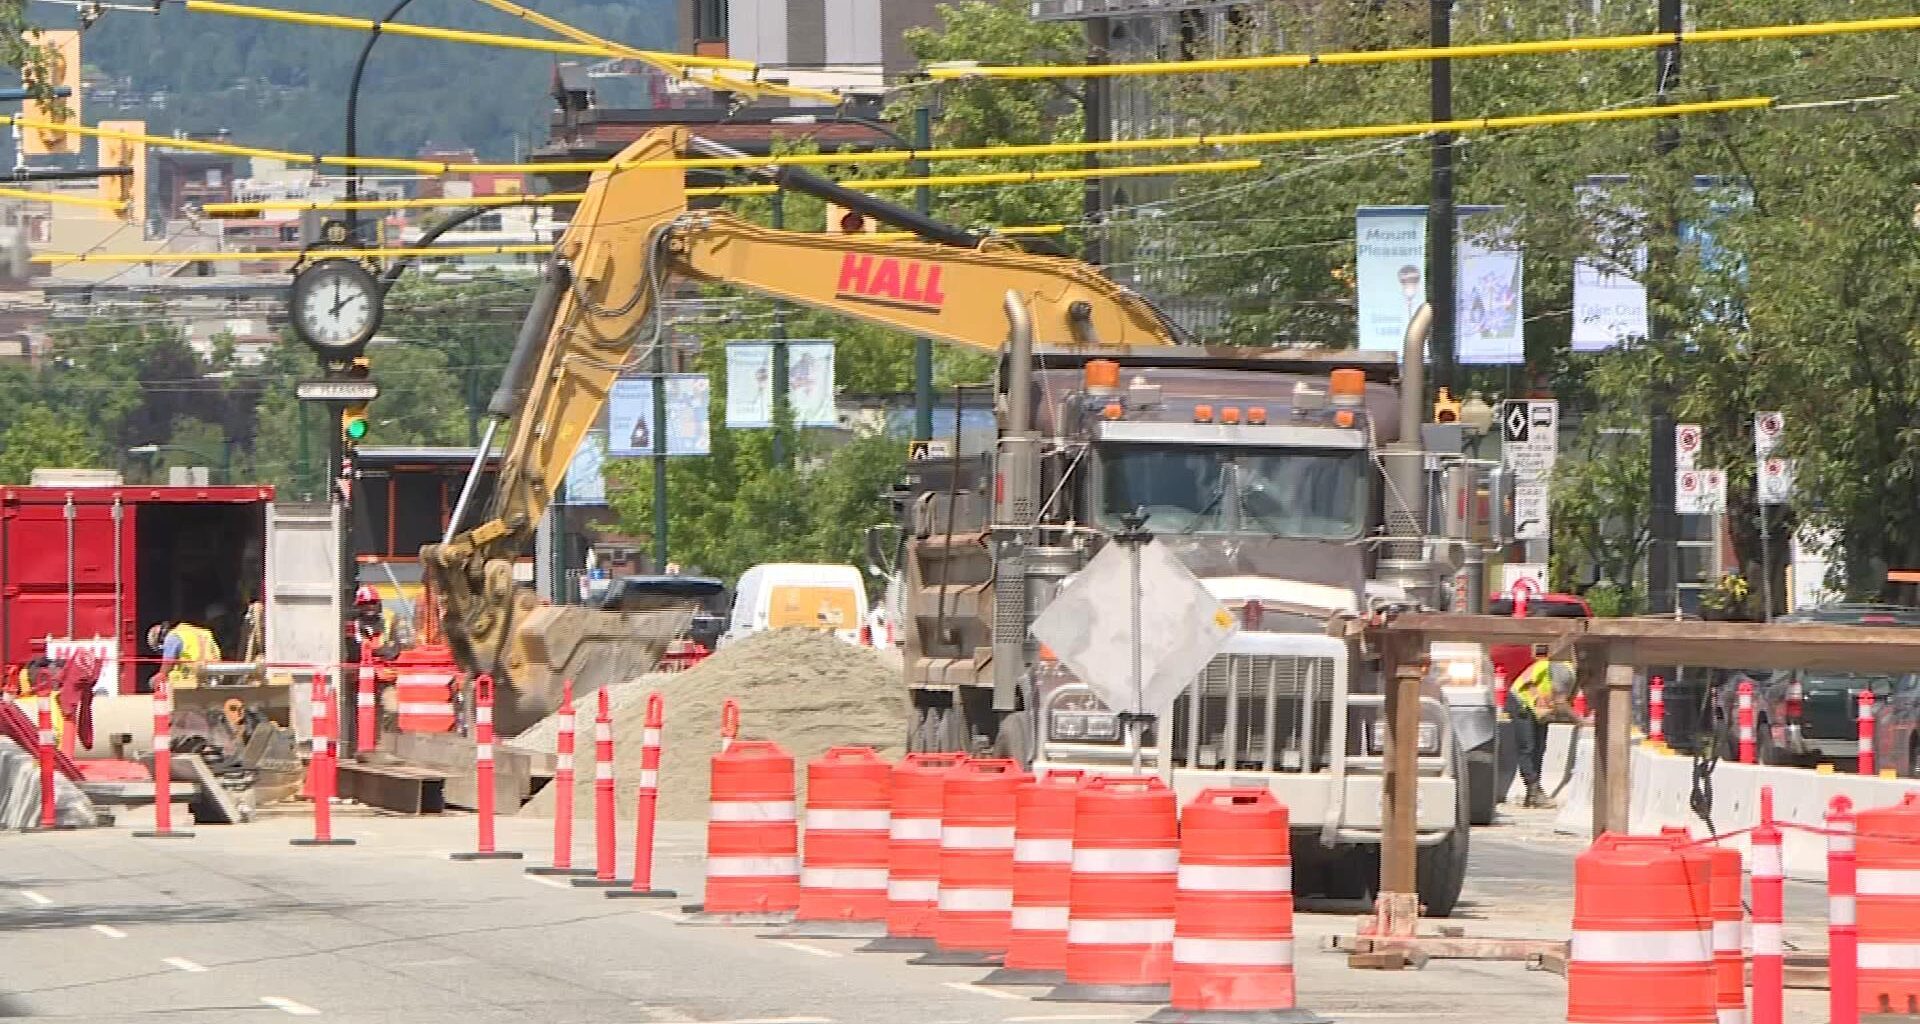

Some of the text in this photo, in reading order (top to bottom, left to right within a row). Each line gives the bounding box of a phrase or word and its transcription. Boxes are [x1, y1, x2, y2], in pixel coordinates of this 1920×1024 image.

[1365, 228, 1417, 241] Mount
[837, 251, 945, 304] HALL
[55, 646, 110, 667] HL
